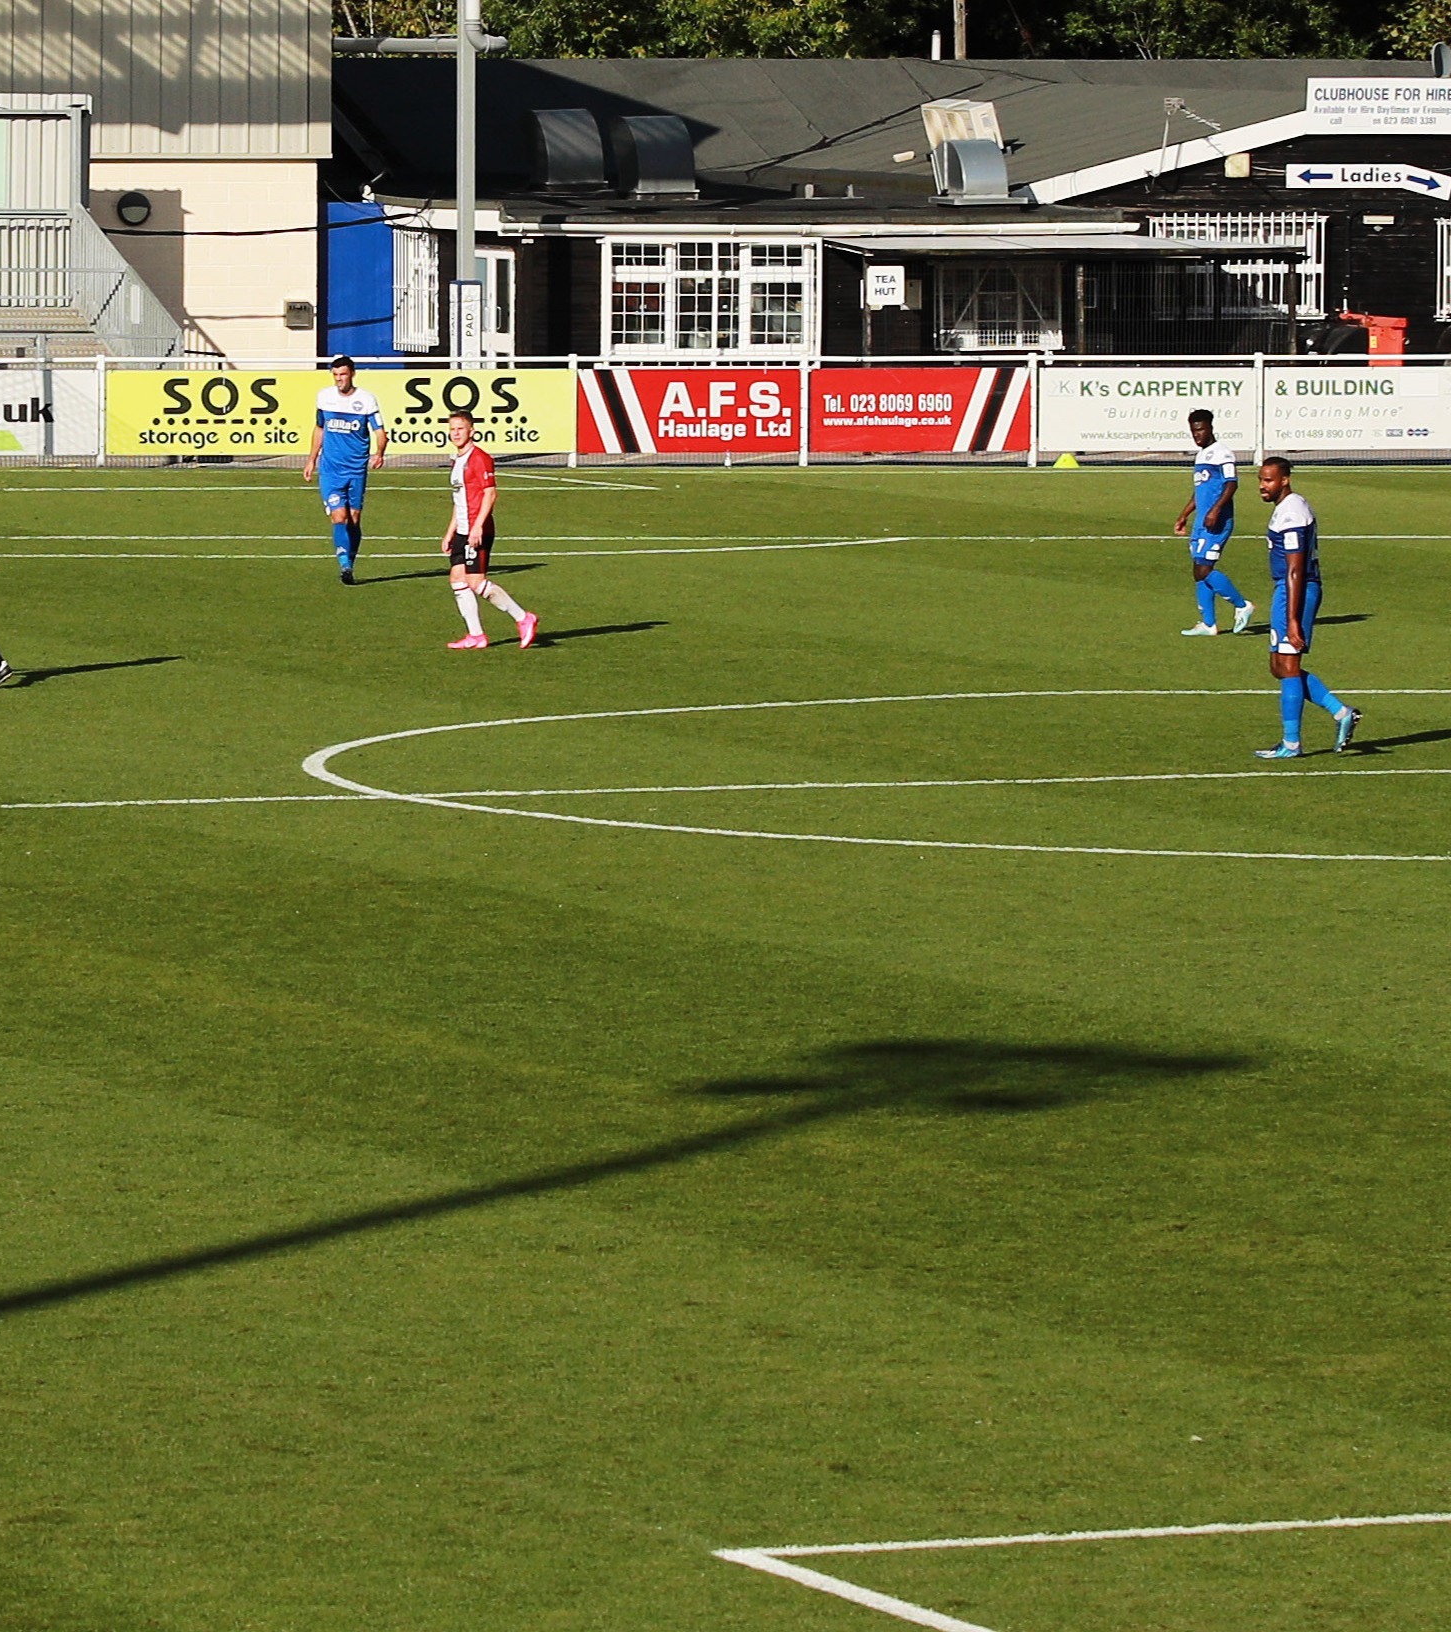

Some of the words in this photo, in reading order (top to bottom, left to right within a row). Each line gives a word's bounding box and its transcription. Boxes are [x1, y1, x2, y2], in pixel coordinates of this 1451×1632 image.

[1314, 88, 1389, 101] CLUBHOUSE
[1394, 88, 1421, 101] FOR
[1341, 168, 1402, 182] Ladies
[875, 275, 896, 283] TEA
[405, 376, 519, 414] SOS
[1080, 381, 1110, 396] K's
[1117, 381, 1243, 396] CARPENTRY
[1275, 380, 1288, 395] &
[1296, 380, 1394, 395] BUILDING
[163, 376, 279, 415] SOS
[659, 381, 792, 418] A.F.S.
[823, 394, 845, 412] Tel.
[850, 394, 876, 412] 023
[879, 394, 913, 412] 8069
[917, 393, 952, 412] 6960
[1274, 407, 1290, 419] by
[1299, 407, 1352, 419] Caring
[823, 415, 952, 427] www.afshaulage.co.uk
[473, 430, 496, 442] on
[505, 427, 540, 442] site
[658, 419, 746, 442] Haulage
[755, 419, 791, 437] Ltd
[1295, 430, 1324, 438] 01489
[1326, 430, 1343, 438] 890
[1346, 430, 1363, 438] 077
[139, 429, 219, 449] storage
[230, 431, 255, 443] on
[264, 428, 300, 443] site
